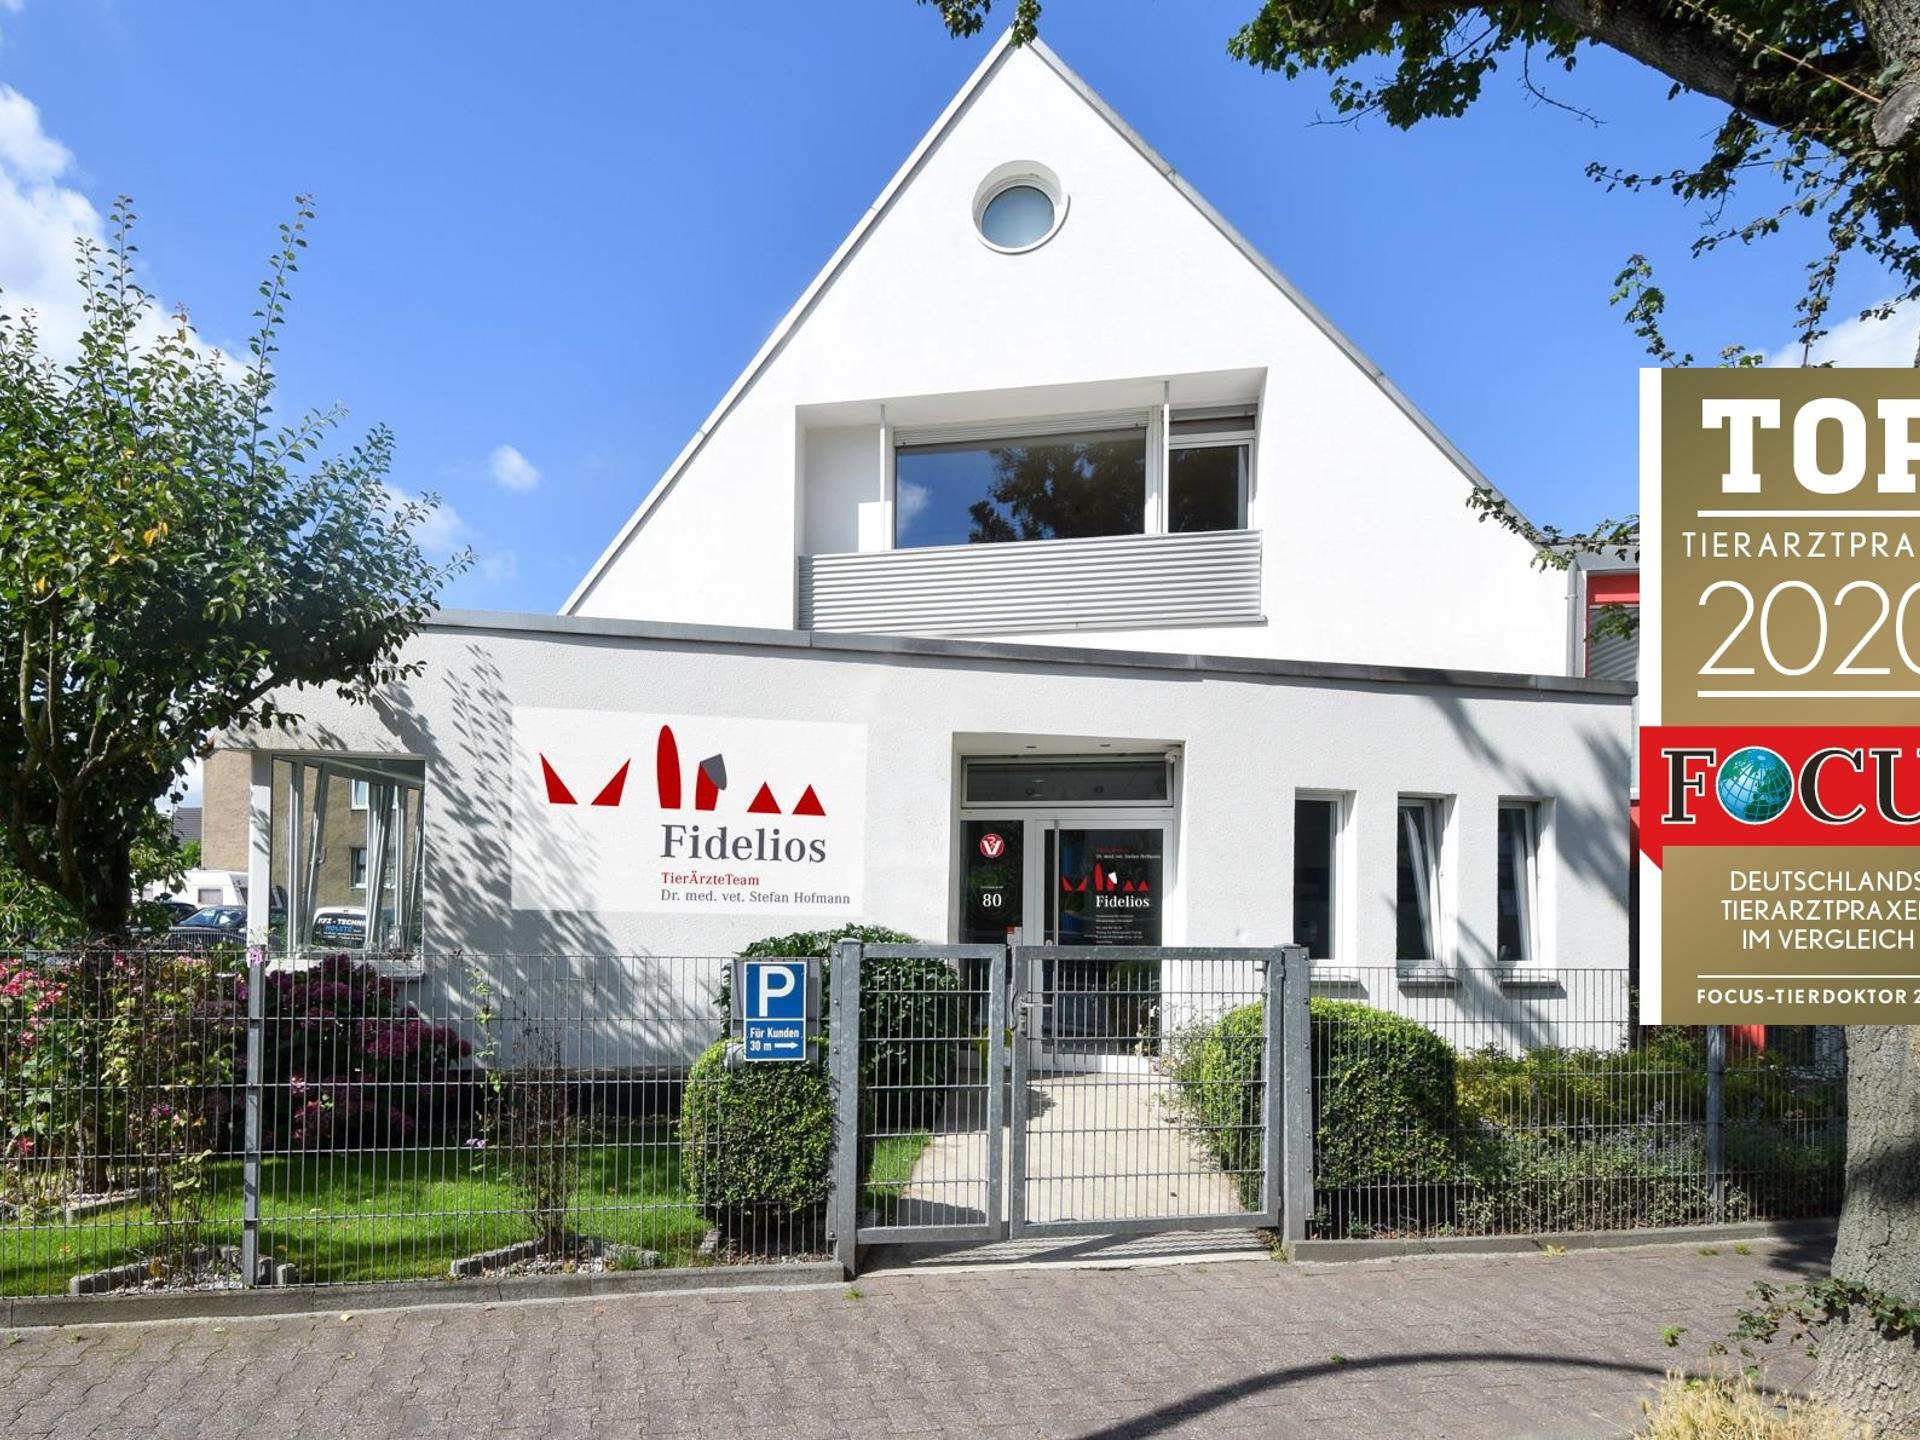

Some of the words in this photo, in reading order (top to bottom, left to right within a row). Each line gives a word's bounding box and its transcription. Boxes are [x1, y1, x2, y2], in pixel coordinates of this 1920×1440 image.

[660, 824, 827, 864] Fidelios
[660, 870, 760, 887] TierÄrzteTeam
[660, 888, 681, 902] Dr.
[685, 890, 717, 903] med.
[722, 892, 746, 904] vet.
[749, 891, 789, 904] Stefan
[794, 892, 851, 905] Hofmann
[983, 893, 1002, 907] 80
[1095, 895, 1150, 908] Fidelios
[758, 965, 795, 1017] P
[750, 1027, 765, 1038] Für
[767, 1027, 800, 1038] Kunden
[750, 1041, 761, 1051] 30
[763, 1043, 772, 1051] m
